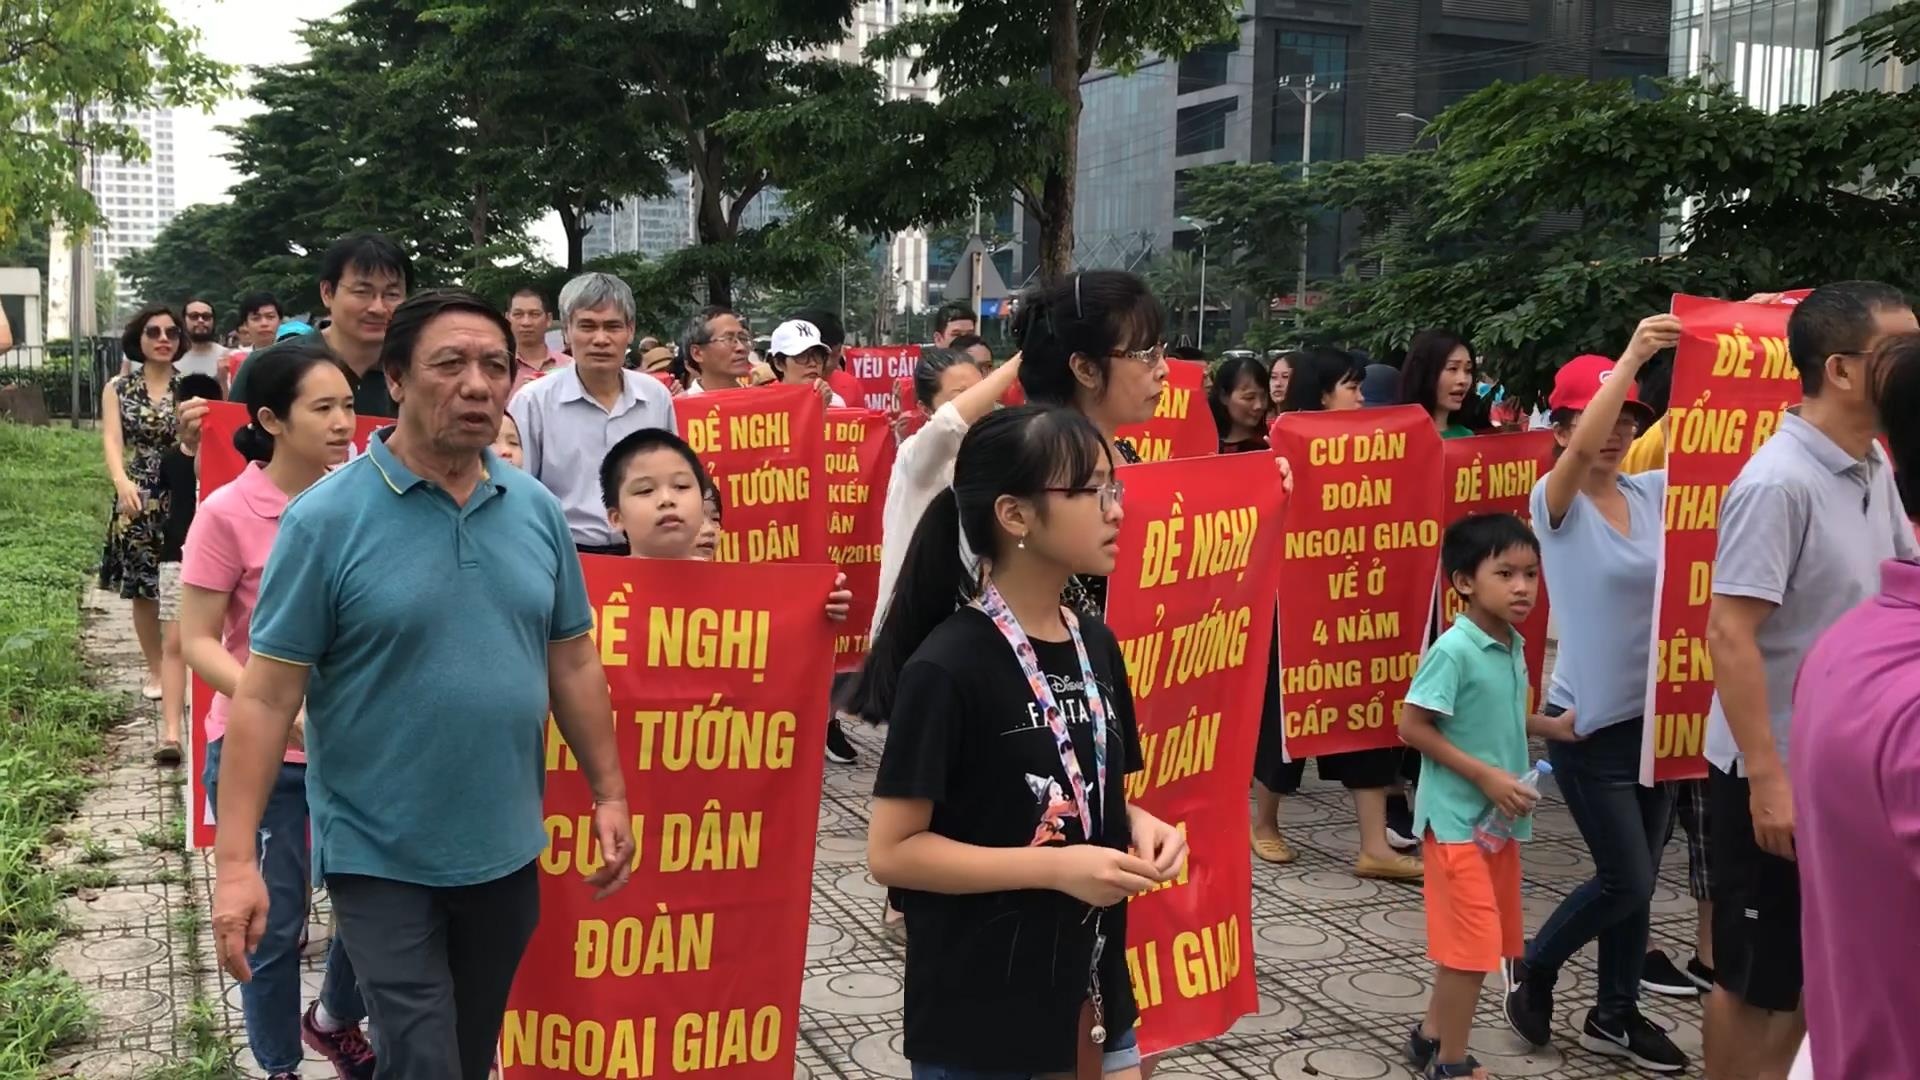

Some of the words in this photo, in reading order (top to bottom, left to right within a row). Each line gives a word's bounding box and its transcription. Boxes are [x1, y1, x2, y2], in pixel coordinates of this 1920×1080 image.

[853, 353, 883, 379] YÊU
[1711, 322, 1754, 378] ĐỀ
[1154, 380, 1190, 419] ÂN
[687, 404, 722, 454] ĐỀ
[729, 412, 790, 453] NGHỊ
[1309, 433, 1349, 466] CƯ
[1353, 428, 1406, 463] DÂN
[727, 459, 810, 508] TƯỚNG
[828, 478, 870, 504] KIẾN
[1322, 474, 1392, 511] ĐOÀN
[1454, 452, 1482, 503] ĐỀ
[827, 511, 855, 534] ÂN
[1664, 485, 1727, 531] THA
[748, 520, 800, 564] DÂN
[1139, 491, 1184, 589] ĐỀ
[1186, 506, 1258, 582] NGHỊ
[1285, 525, 1366, 560] NGOẠI
[1374, 519, 1439, 551] GIAO
[1328, 561, 1360, 600] VỀ
[1367, 557, 1387, 596] Ở
[647, 606, 770, 683] NGHỊ
[1164, 598, 1251, 689] TƯỚNG
[1312, 619, 1329, 646] 4
[1337, 608, 1400, 644] NĂM
[1656, 628, 1715, 692] BỆN
[634, 693, 797, 772] TƯỚNG
[1285, 698, 1339, 738] CẤP
[1346, 690, 1385, 730] SỔ
[1654, 713, 1709, 758] UN
[1155, 705, 1222, 789] DÂN
[659, 799, 763, 874] DÂN
[574, 902, 715, 979] ĐOÀN
[1172, 913, 1241, 999] GIAO
[672, 1004, 782, 1074] GIAO
